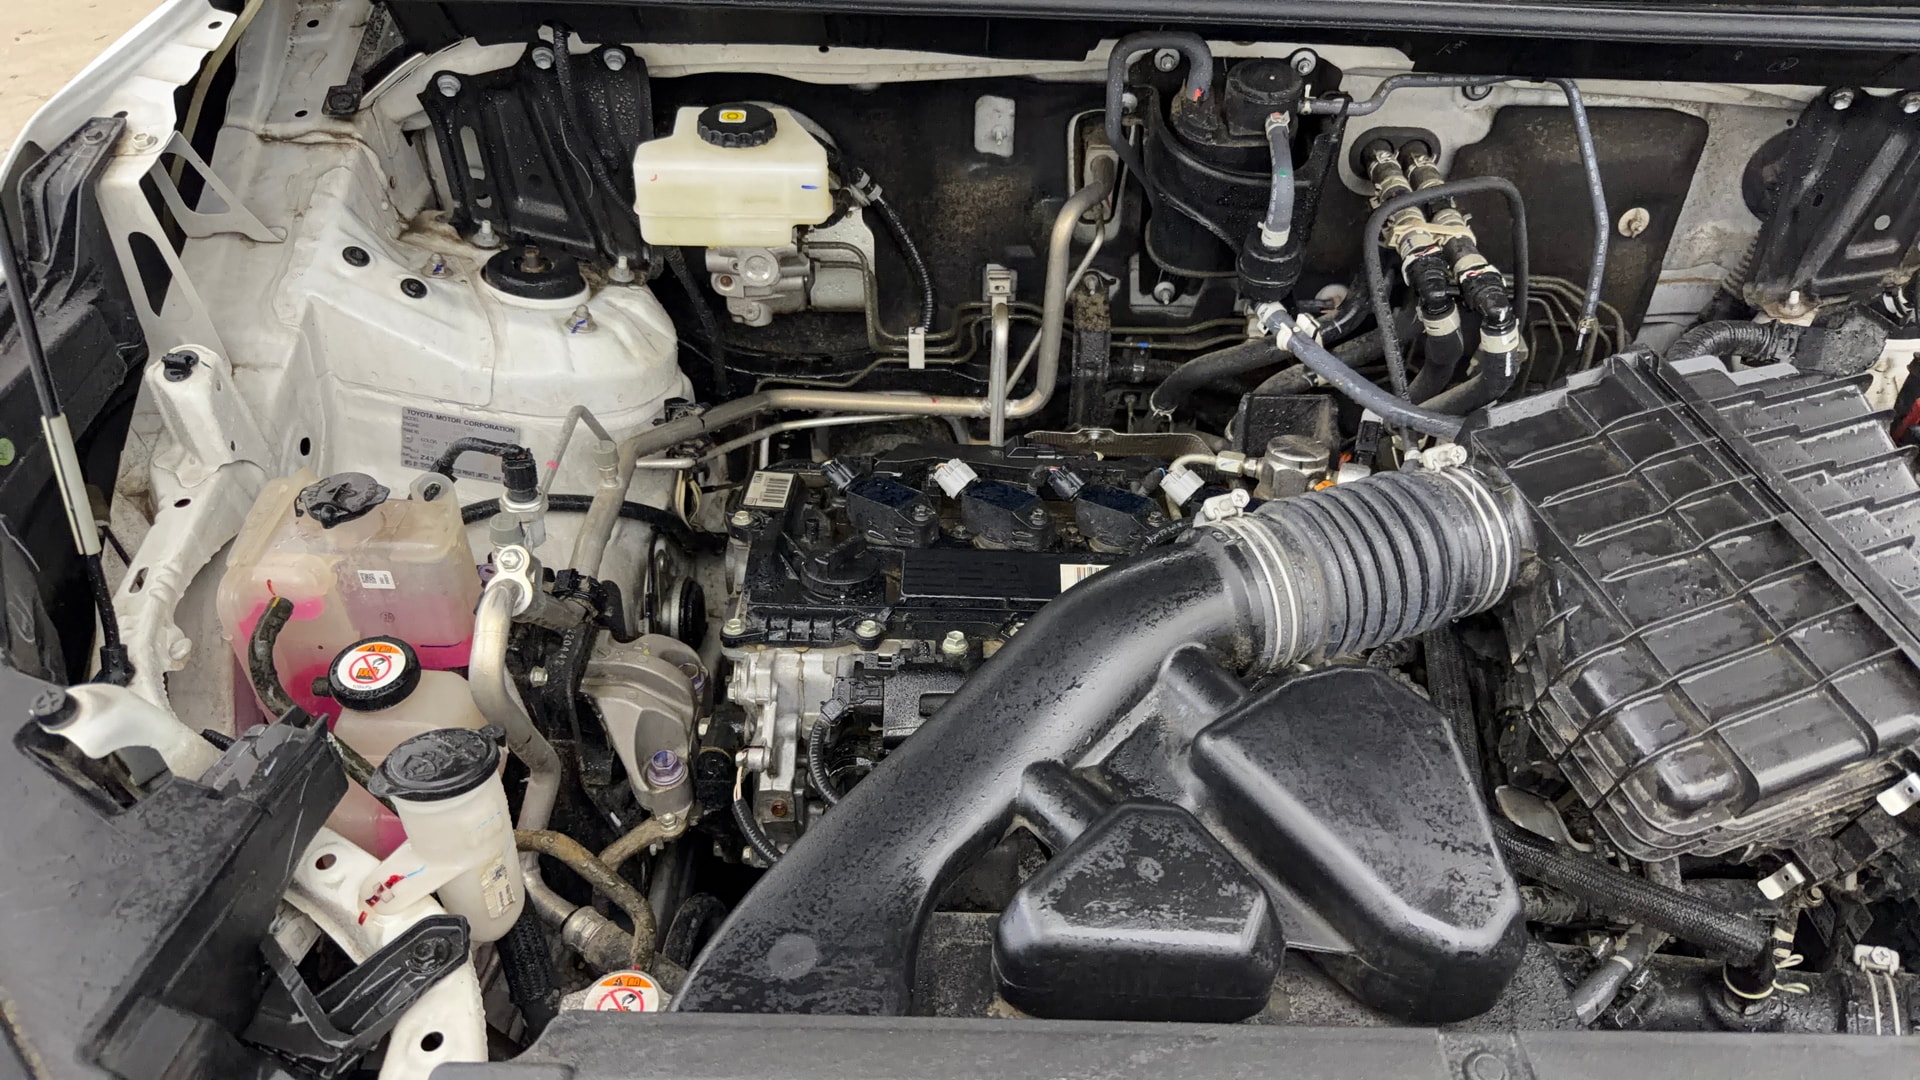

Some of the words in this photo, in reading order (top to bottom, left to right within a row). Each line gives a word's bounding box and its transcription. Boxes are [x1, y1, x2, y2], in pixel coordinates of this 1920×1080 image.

[407, 409, 433, 419] TOYOTA
[436, 414, 461, 424] MOTOR
[463, 419, 516, 433] CORPORATION
